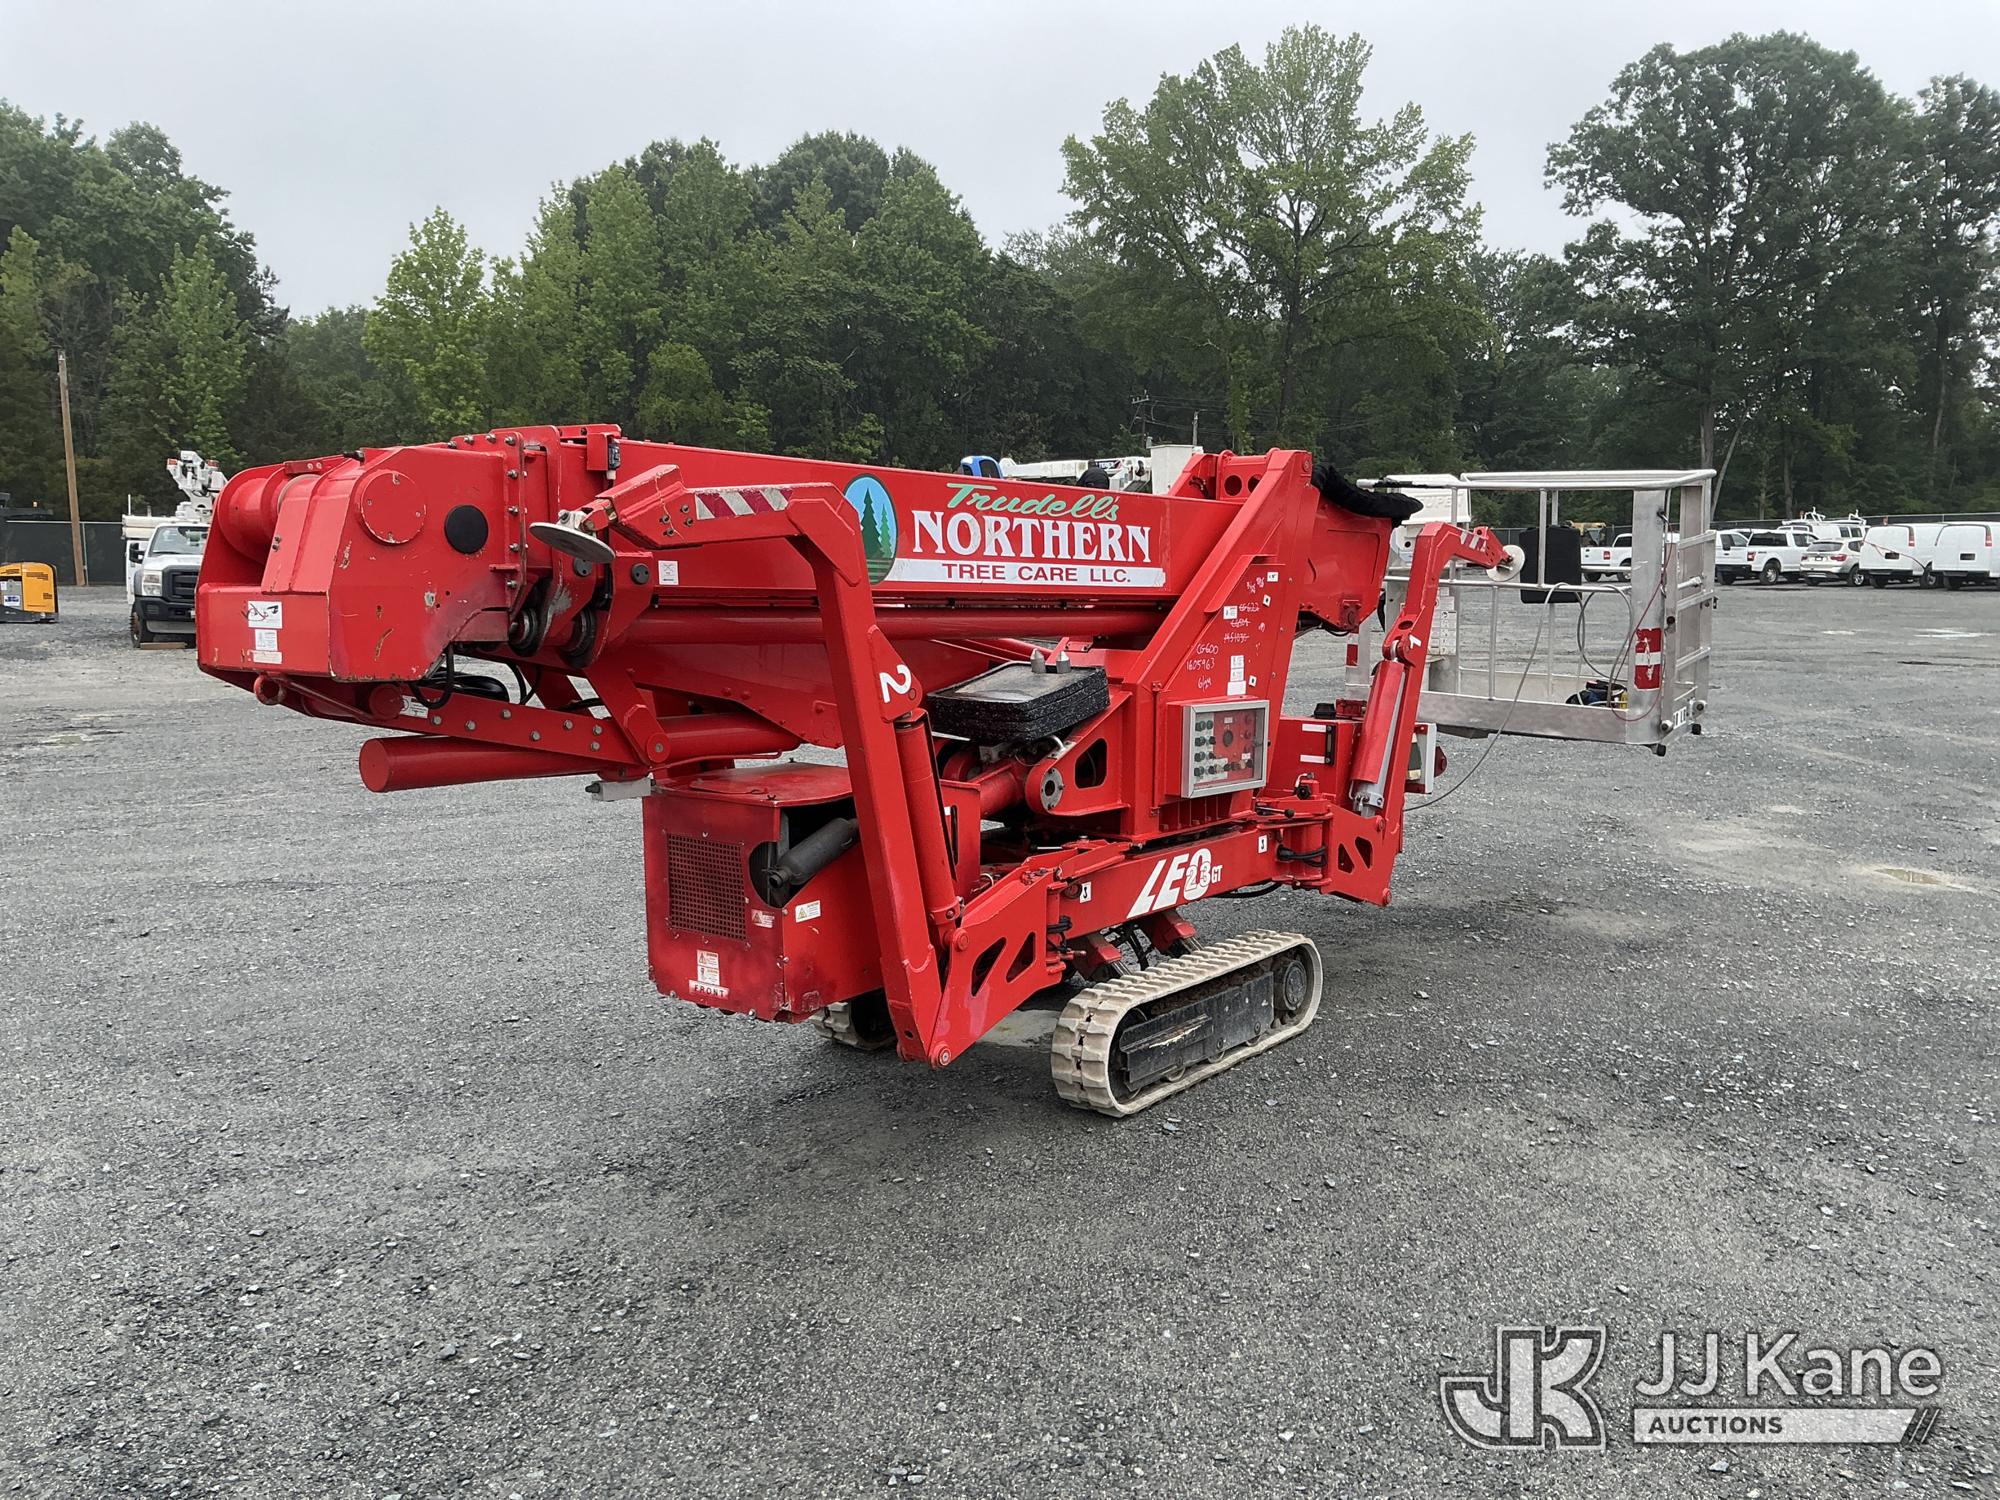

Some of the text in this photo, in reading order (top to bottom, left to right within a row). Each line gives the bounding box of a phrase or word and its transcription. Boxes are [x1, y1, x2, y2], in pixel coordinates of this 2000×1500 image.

[946, 482, 1120, 521] Trudell's
[912, 510, 1152, 563] NORTHERN
[942, 563, 1131, 583] TREE CARE LLC.
[879, 664, 912, 703] 2
[1126, 848, 1212, 919] LEO
[694, 984, 725, 997] FRONT
